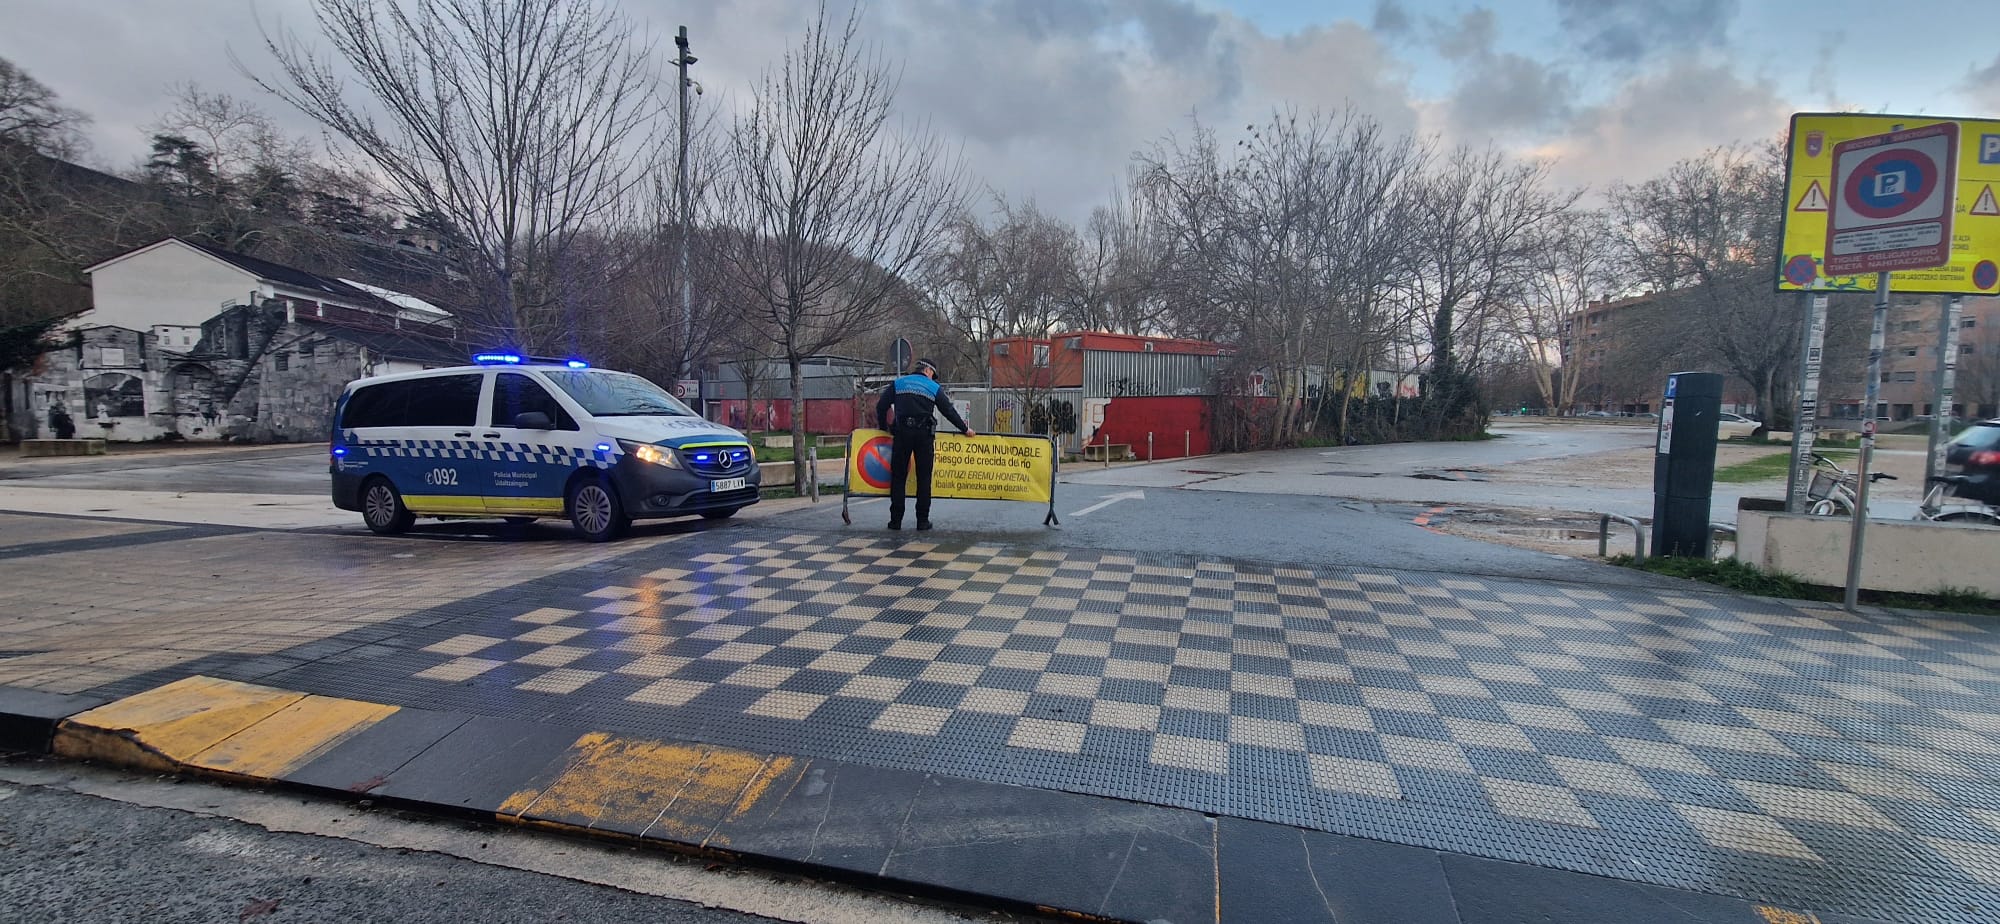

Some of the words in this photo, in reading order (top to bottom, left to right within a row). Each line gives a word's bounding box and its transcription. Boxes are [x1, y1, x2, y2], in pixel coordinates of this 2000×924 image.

[1867, 247, 1938, 261] OBLIGATORIO
[1830, 262, 1863, 271] TIKETA
[1668, 378, 1677, 396] P
[934, 441, 963, 453] LIGRO.
[966, 443, 990, 454] ZONA
[992, 444, 1042, 458] INUNDABLE.
[934, 453, 962, 466] Riesgo
[964, 454, 974, 464] de
[976, 455, 1006, 467] crecida
[433, 468, 459, 485] 092
[512, 471, 537, 479] Municipal
[933, 469, 966, 479] KONTUZ!
[968, 470, 994, 480] EREMU
[716, 480, 731, 490] 5887
[935, 479, 955, 489] Ibaiak
[956, 481, 986, 492] gainezka
[988, 483, 1002, 493] egin
